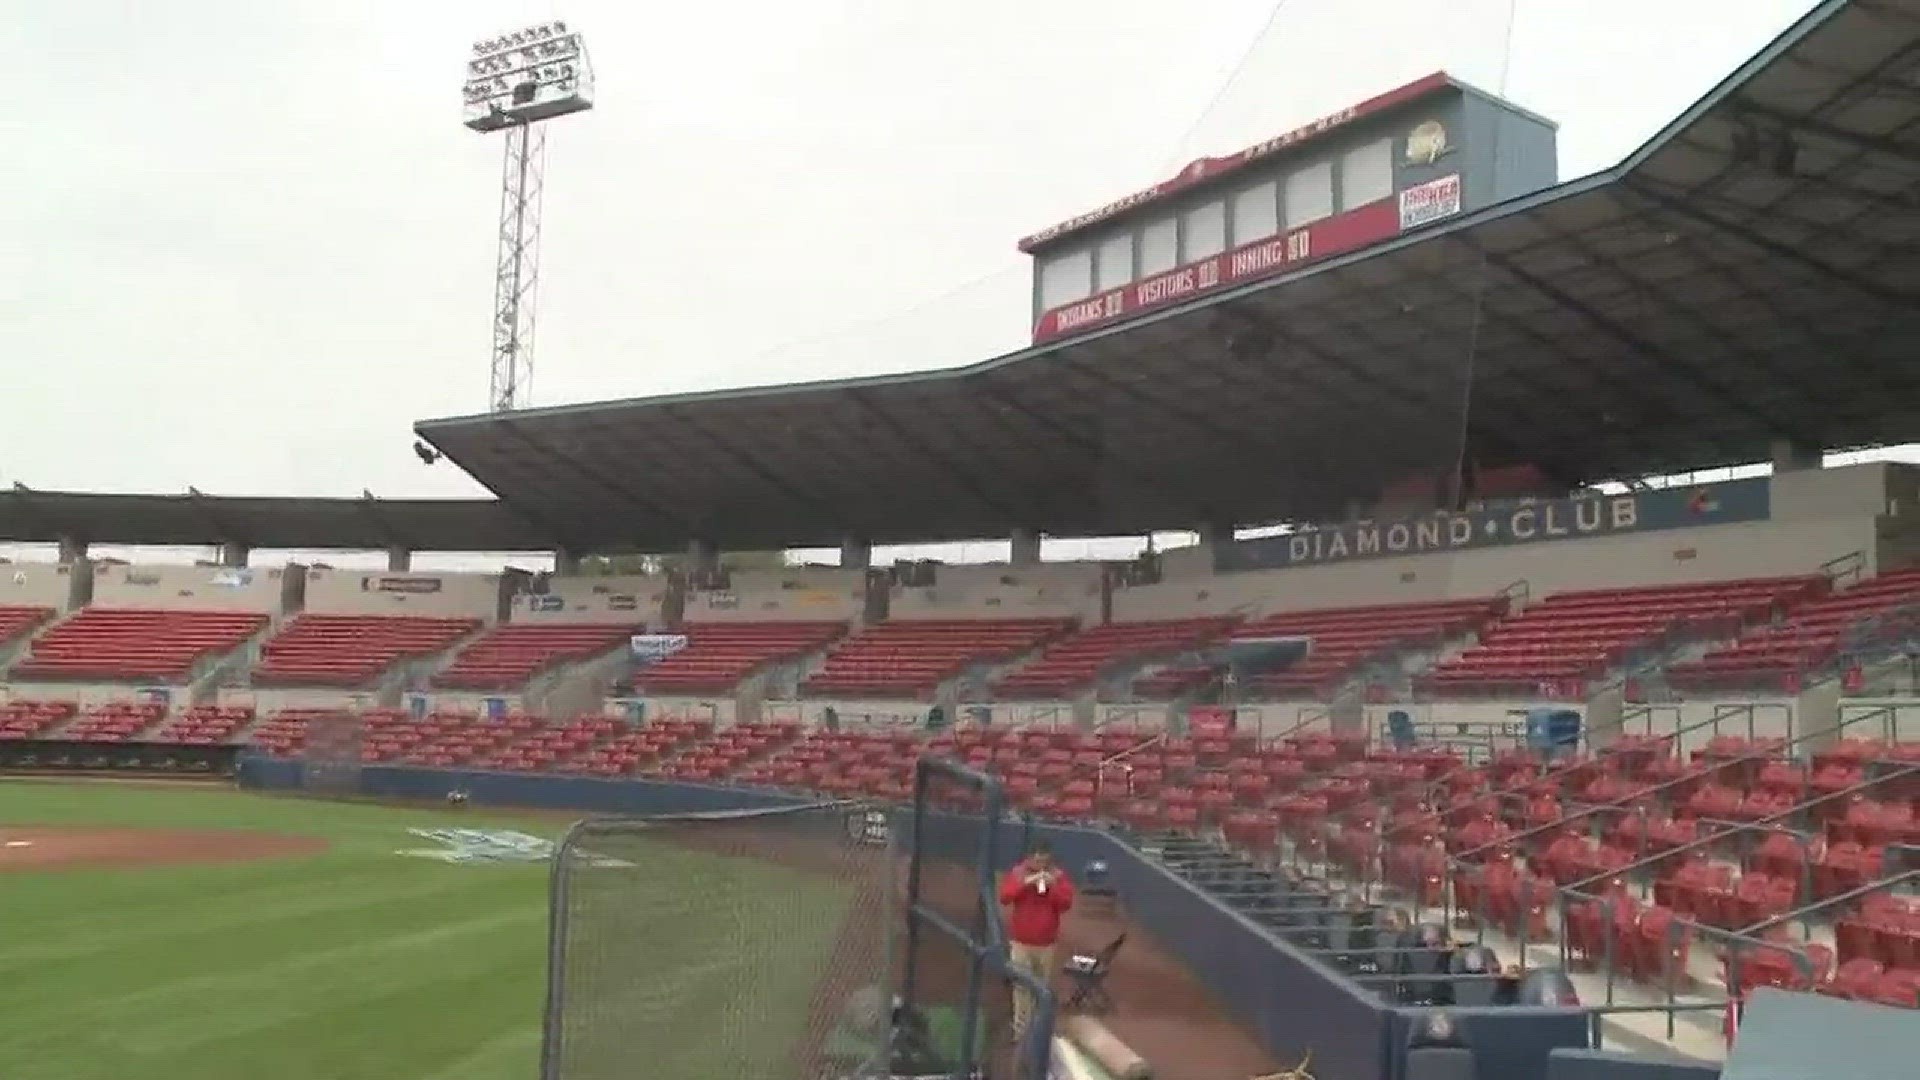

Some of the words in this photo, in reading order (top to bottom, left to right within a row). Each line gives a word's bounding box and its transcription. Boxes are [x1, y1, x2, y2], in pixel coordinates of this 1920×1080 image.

[1057, 298, 1104, 332] INDIANS
[1137, 268, 1193, 305] VISITORS
[1231, 241, 1283, 279] INNING
[1288, 516, 1472, 563] DIAMOND
[1511, 496, 1638, 539] CLUB
